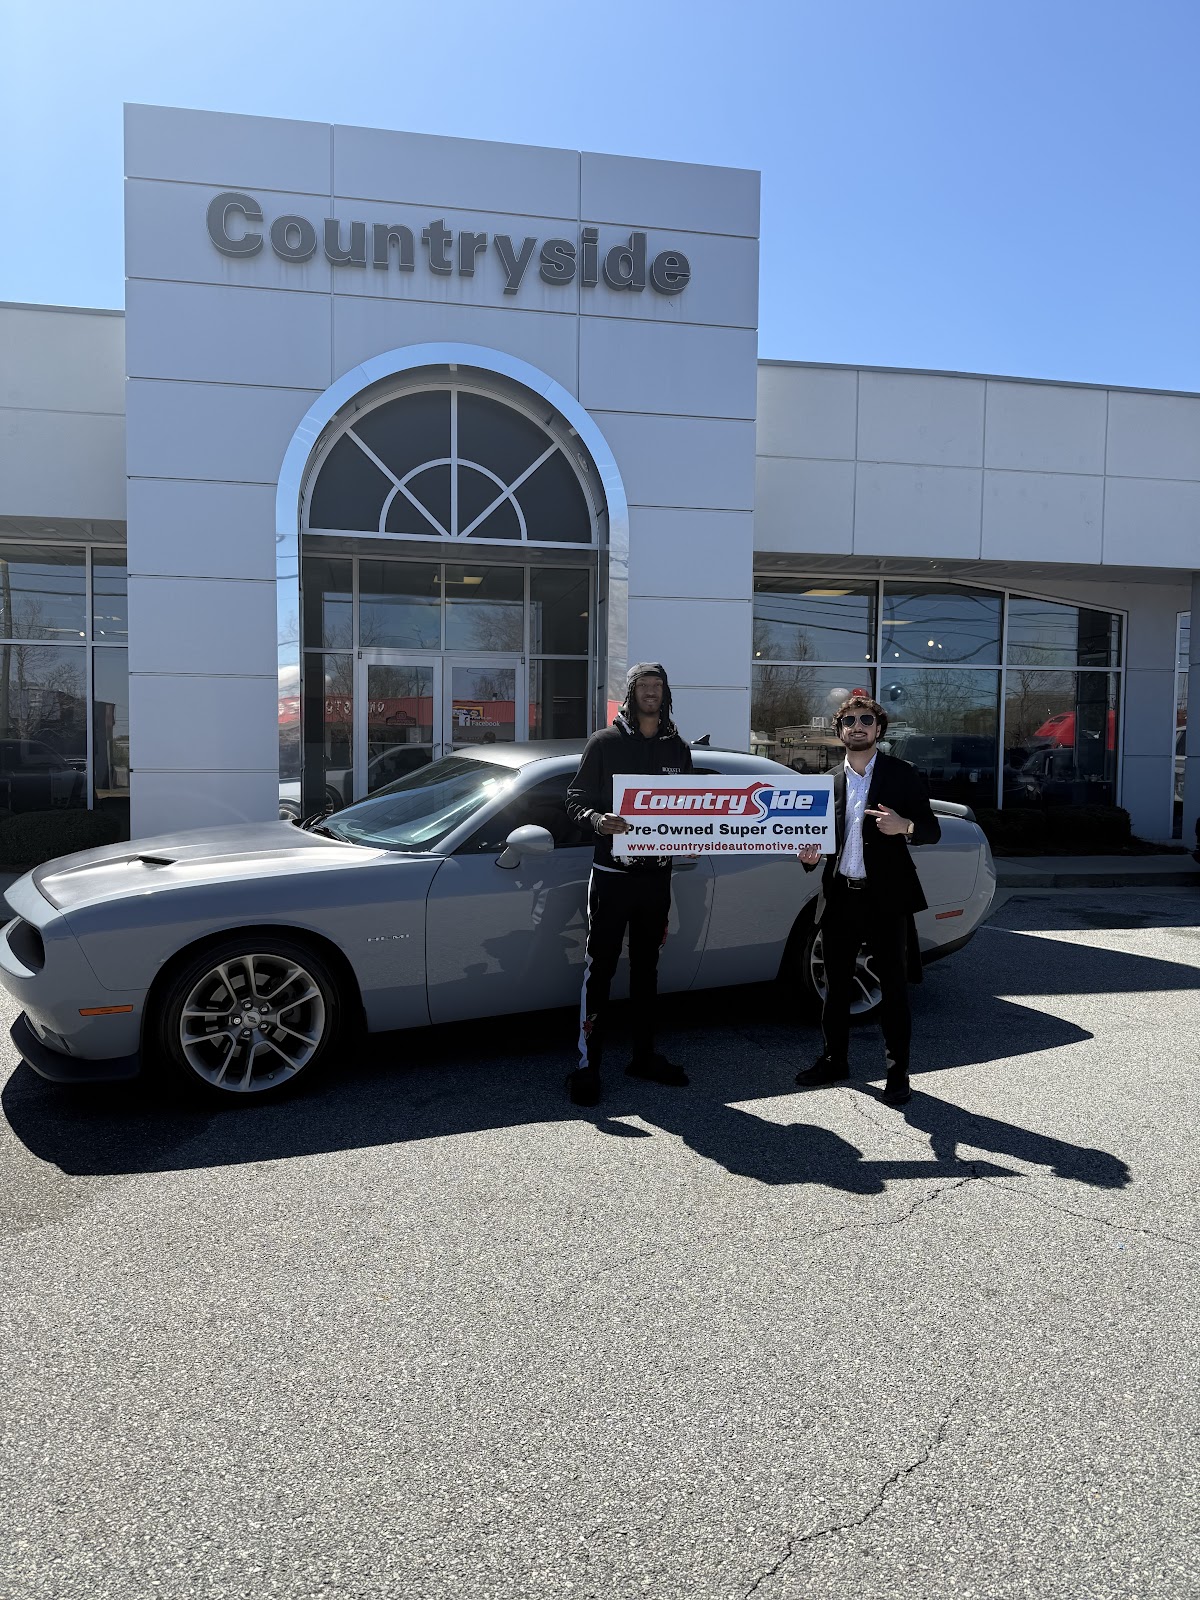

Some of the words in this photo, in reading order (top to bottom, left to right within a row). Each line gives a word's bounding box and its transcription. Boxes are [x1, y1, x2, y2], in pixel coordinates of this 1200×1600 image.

[206, 191, 692, 296] Countryside
[624, 823, 714, 835] Pre-Owned
[719, 823, 767, 837] Super
[772, 823, 828, 835] Center
